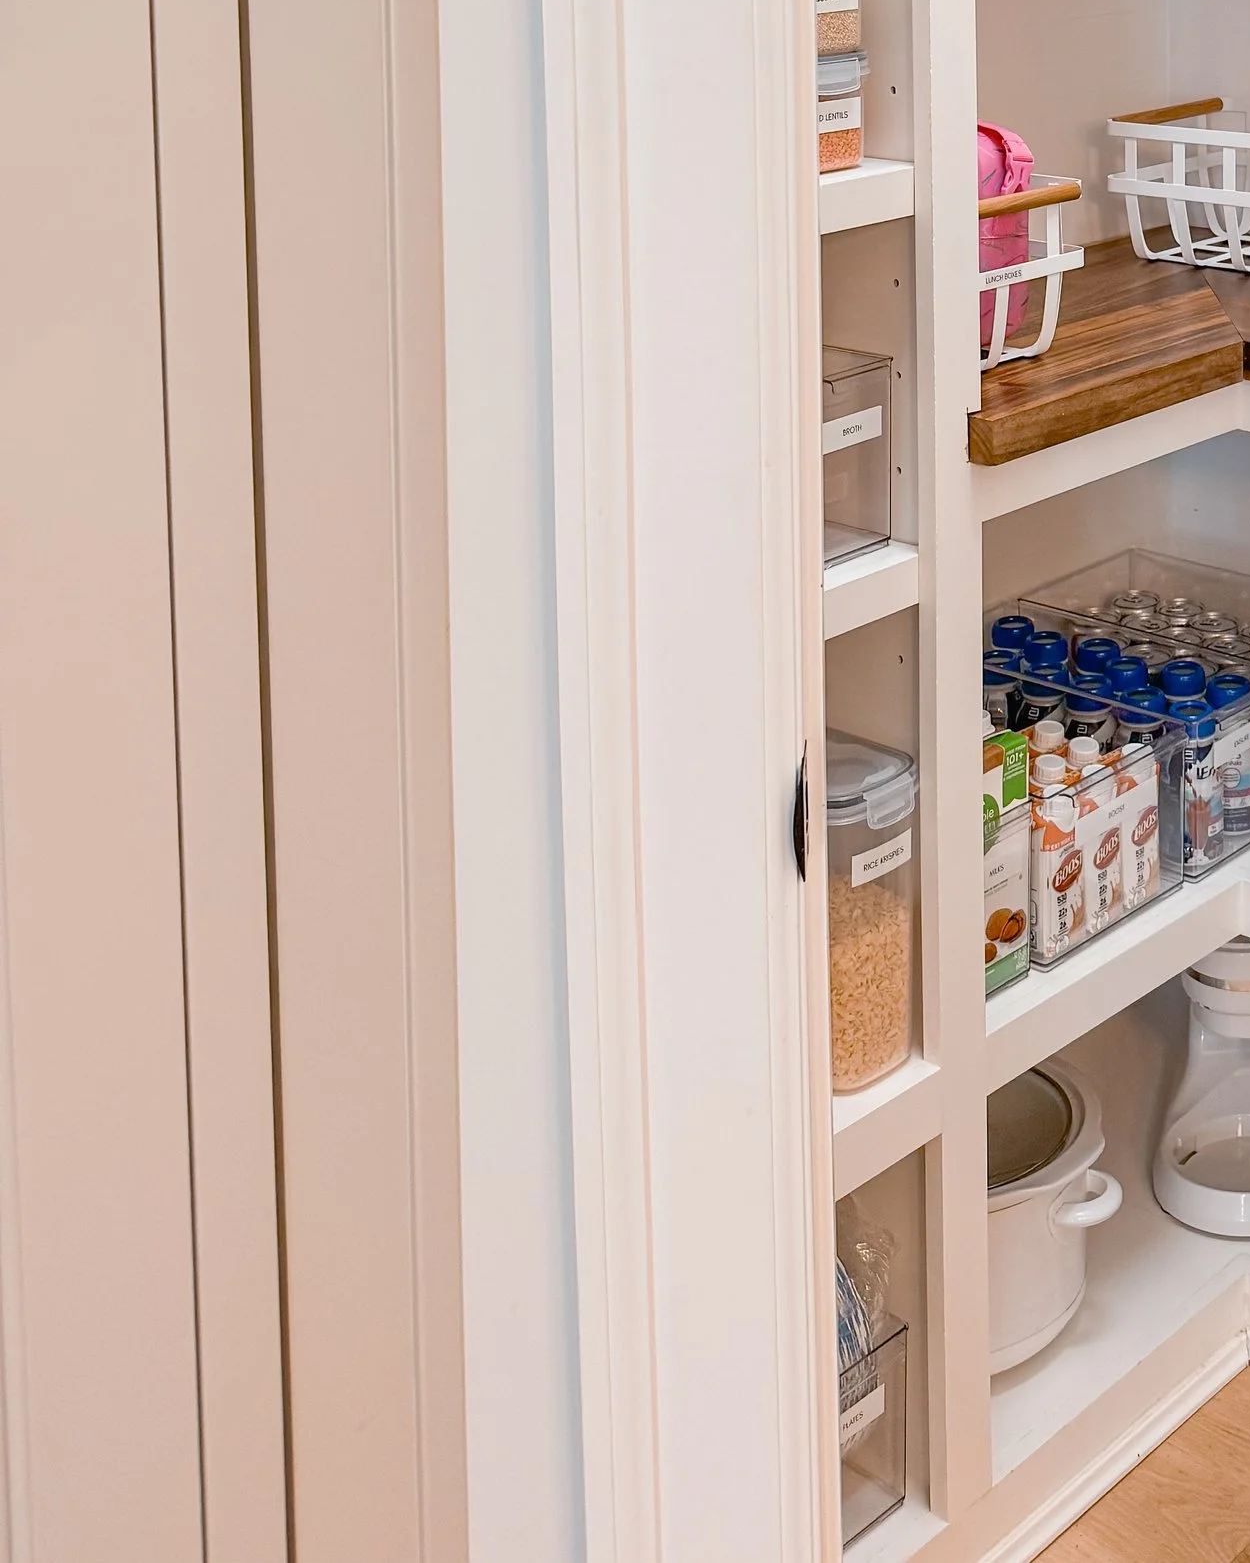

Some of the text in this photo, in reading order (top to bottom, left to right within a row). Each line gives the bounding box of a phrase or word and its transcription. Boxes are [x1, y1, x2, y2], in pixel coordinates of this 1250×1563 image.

[825, 110, 849, 122] LENTILS
[985, 269, 1022, 285] LUNCH BOXES
[842, 423, 863, 437] BROTH
[1006, 751, 1024, 767] 101+
[1133, 810, 1157, 842] BOOS
[863, 858, 879, 872] RICE
[1055, 852, 1082, 888] BOOST
[842, 1411, 864, 1432] PLATES
